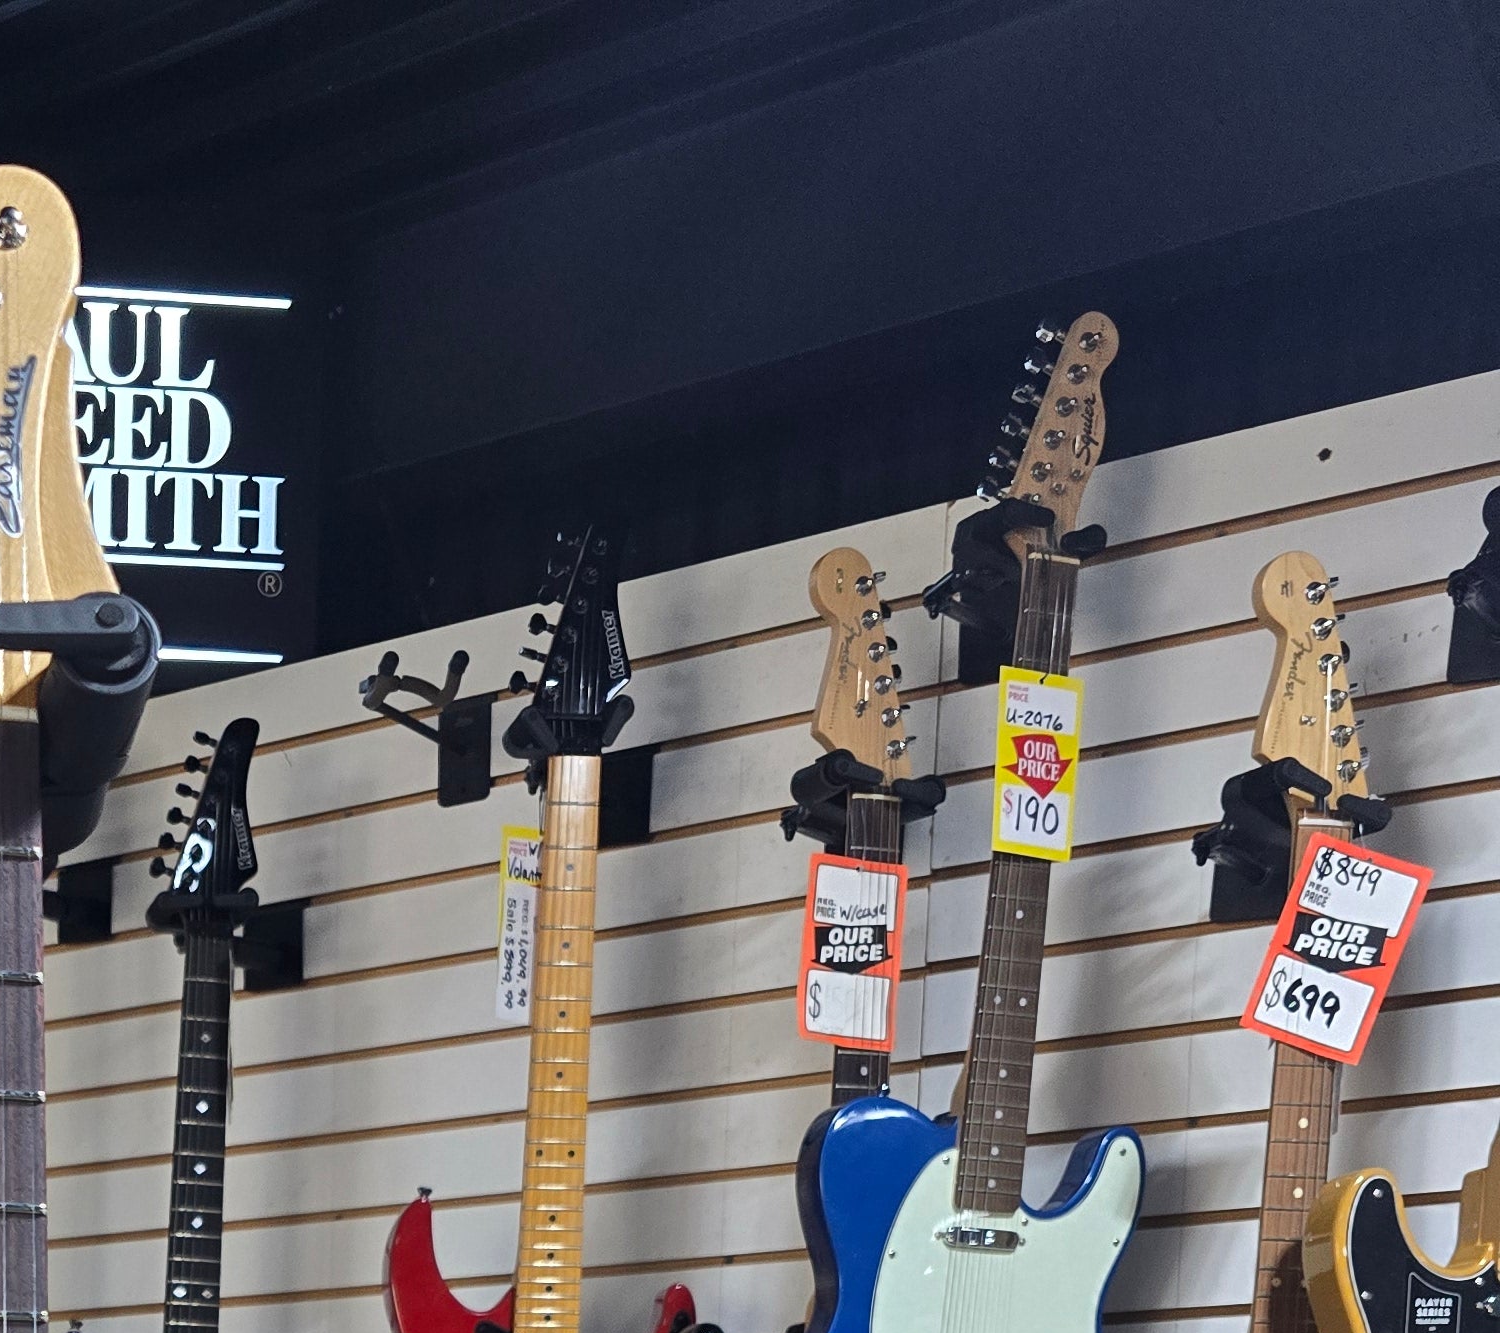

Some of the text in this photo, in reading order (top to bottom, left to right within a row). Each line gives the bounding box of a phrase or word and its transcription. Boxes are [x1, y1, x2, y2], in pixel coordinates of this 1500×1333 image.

[1072, 393, 1099, 466] Squier
[602, 610, 625, 679] Kramer
[1284, 631, 1314, 701] Fender
[1008, 691, 1029, 703] PRICE
[1023, 739, 1056, 762] OUR
[1017, 757, 1061, 782] PRICE
[1002, 789, 1060, 836] $190
[1314, 847, 1383, 897] $849
[1303, 889, 1329, 909] PRICE
[816, 905, 836, 919] PRICE
[828, 926, 874, 946] OUR
[1310, 917, 1370, 945] OUR
[819, 943, 885, 964] PRICE
[1293, 933, 1378, 966] PRICE
[1265, 966, 1341, 1029] $699
[1415, 1297, 1453, 1308] PLAYER
[1416, 1307, 1451, 1317] SERIES
